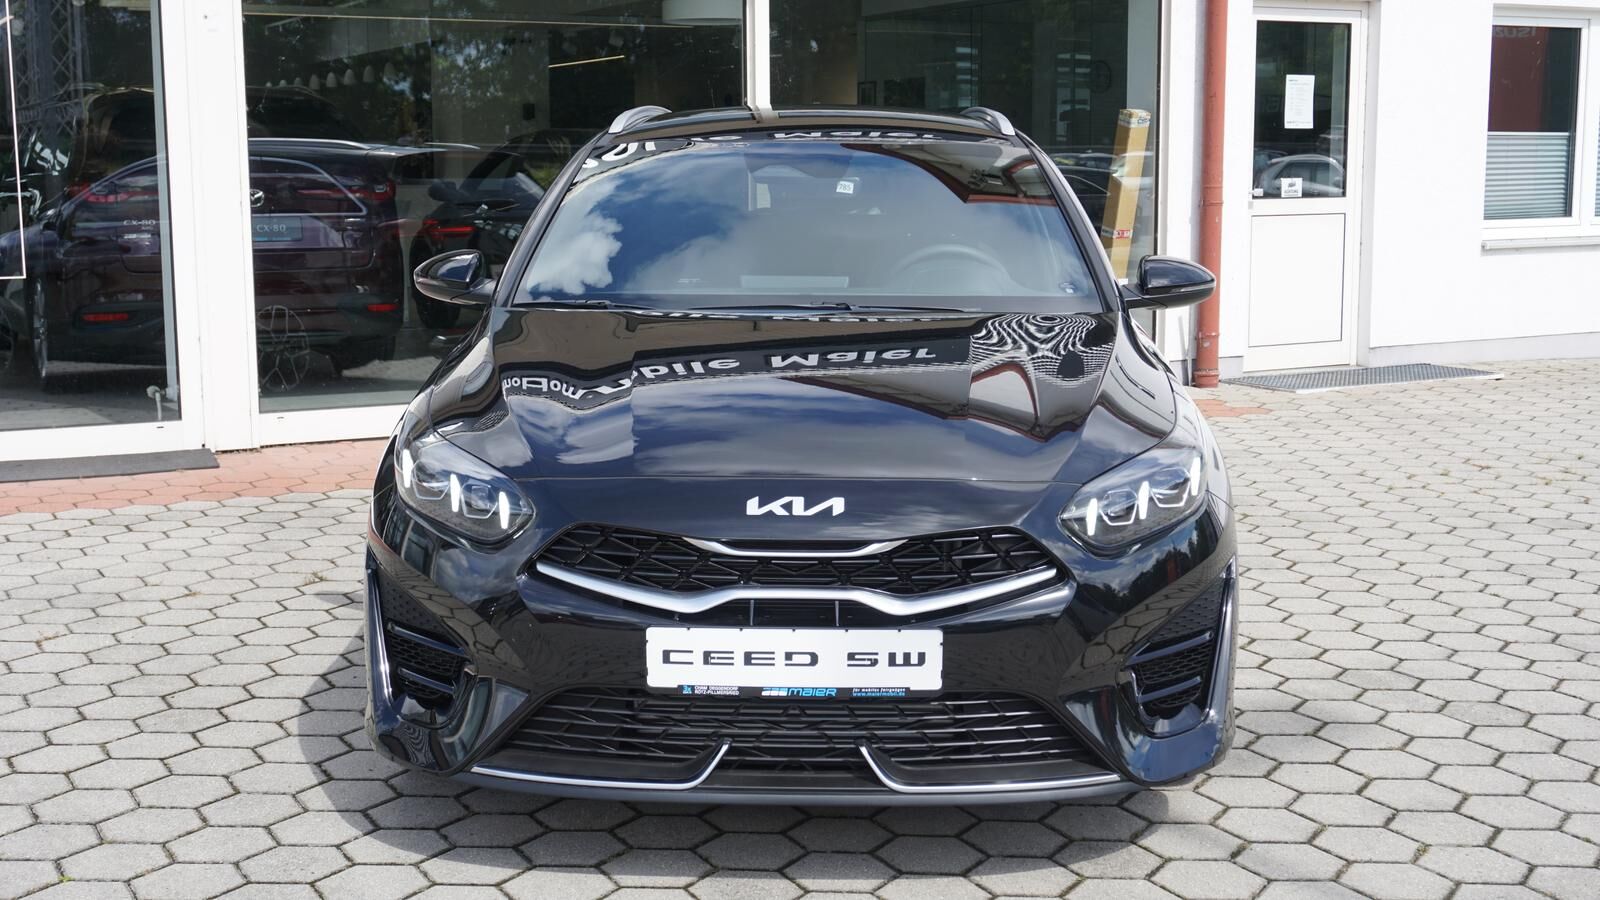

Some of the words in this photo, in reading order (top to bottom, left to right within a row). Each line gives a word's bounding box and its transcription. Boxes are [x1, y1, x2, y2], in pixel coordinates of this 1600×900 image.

[256, 223, 286, 233] CX-80
[662, 649, 819, 667] CEED
[847, 651, 927, 668] SW
